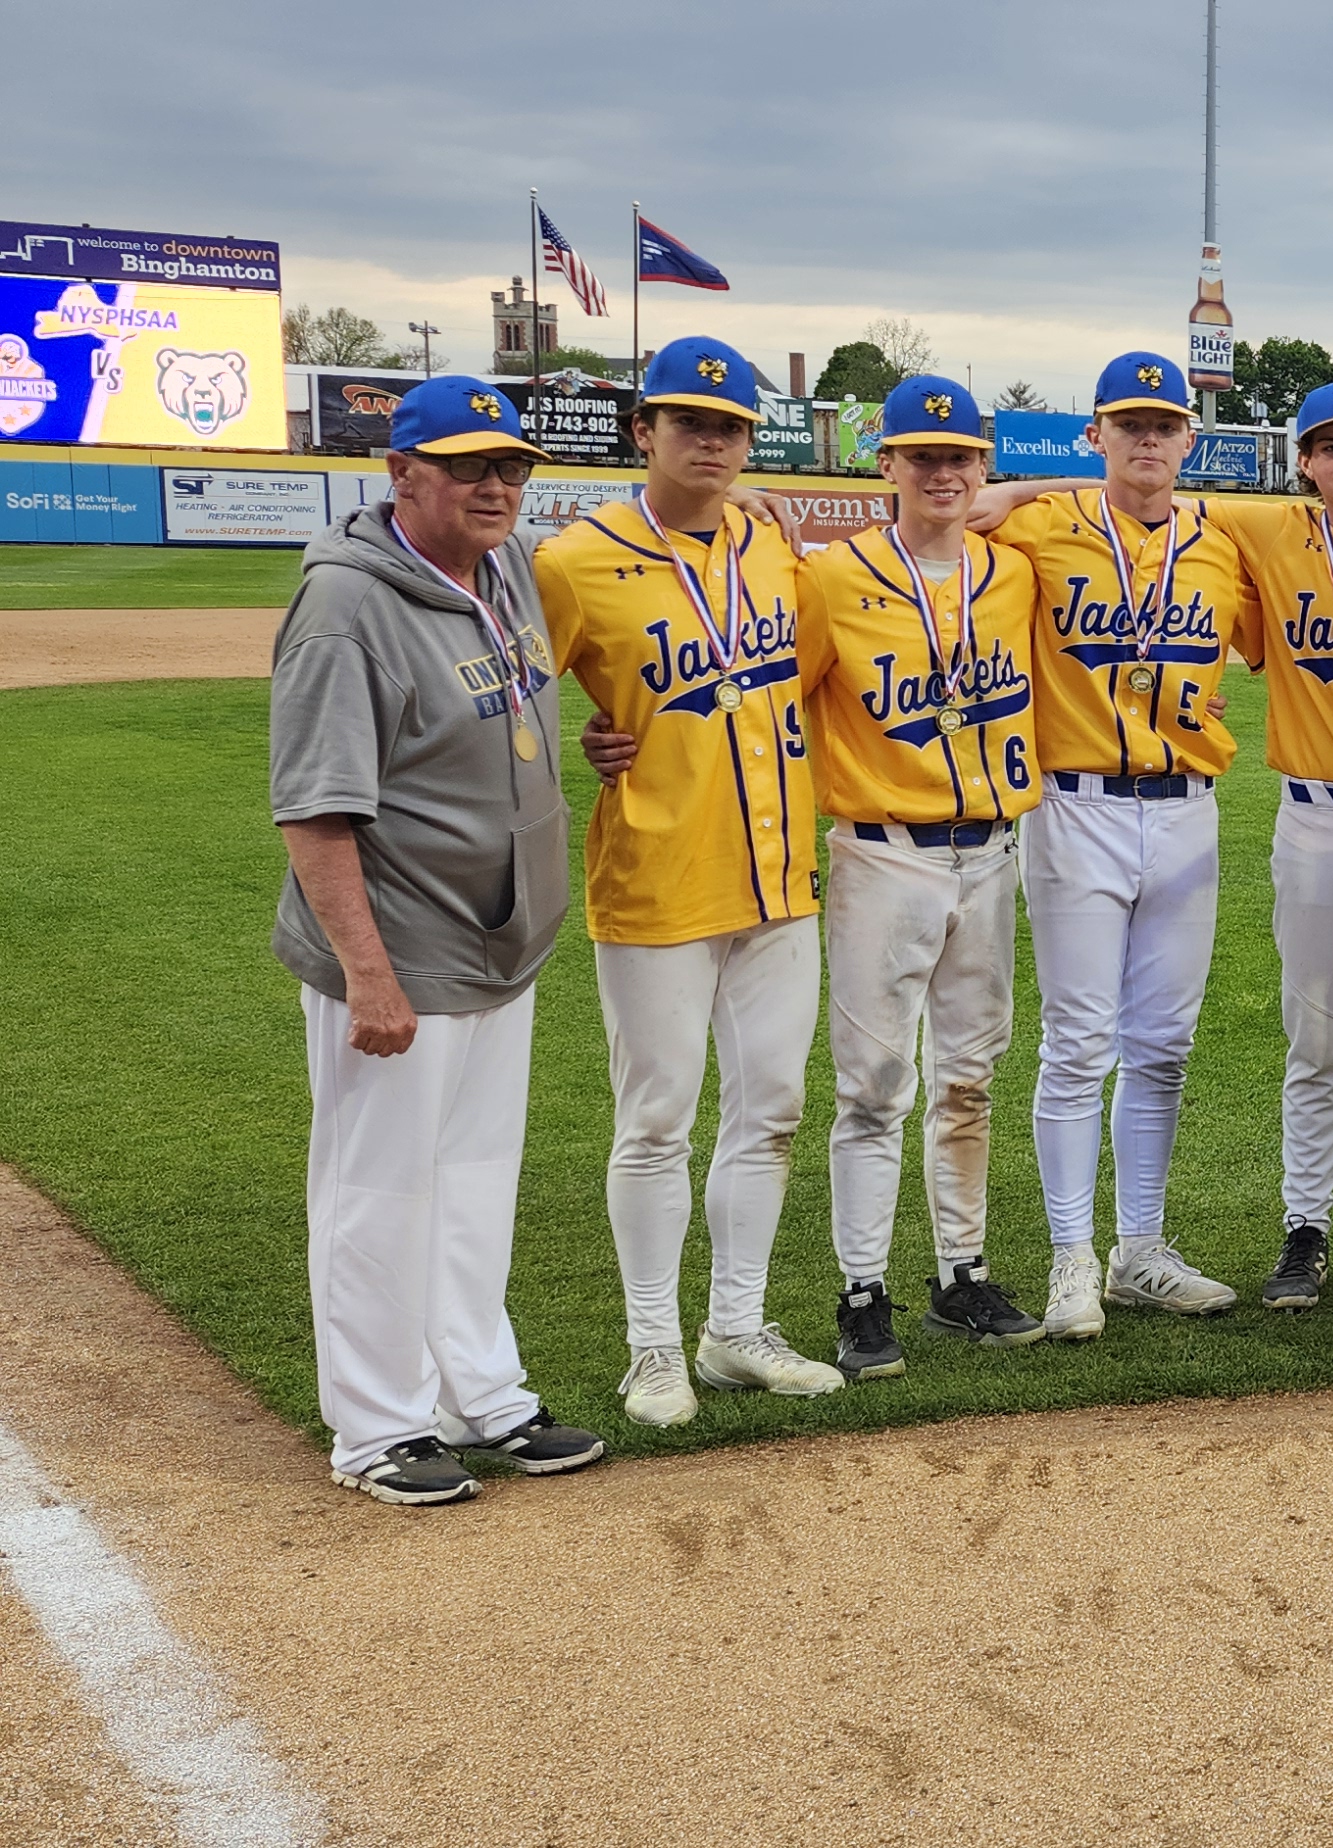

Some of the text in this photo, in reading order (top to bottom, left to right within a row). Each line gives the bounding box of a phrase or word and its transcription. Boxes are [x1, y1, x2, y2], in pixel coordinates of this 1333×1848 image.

[77, 236, 275, 262] welcome to downtown
[121, 254, 276, 281] Binghamton
[61, 305, 177, 329] NYSPHSAA
[1190, 335, 1232, 352] Blue
[1190, 351, 1232, 366] LIGHT
[0, 379, 55, 397] JACKETS
[349, 397, 403, 415] AN
[556, 399, 617, 414] ROOFING
[520, 414, 618, 433] 67-743-902
[755, 430, 812, 444] OFING
[748, 449, 785, 458] 3-9999
[1002, 436, 1070, 456] Excellus
[1210, 462, 1246, 473] SIGNS
[226, 481, 308, 492] SURE TEMP
[536, 483, 570, 491] SERVICE
[6, 492, 49, 509] SoFi
[76, 503, 137, 512] Money Right
[96, 495, 118, 503] Your
[519, 492, 603, 517] MTS
[176, 503, 316, 513] HEATING AIR CONDITIONING
[208, 513, 283, 522] REFRIGERATION
[813, 519, 865, 527] INSURANCE
[185, 527, 312, 537] www.SURETEMP.com
[1052, 576, 1218, 639] Jackets
[641, 596, 797, 696] Jakets
[862, 638, 1024, 721] Jackets
[1176, 679, 1203, 732] 5
[1005, 735, 1030, 790] 6
